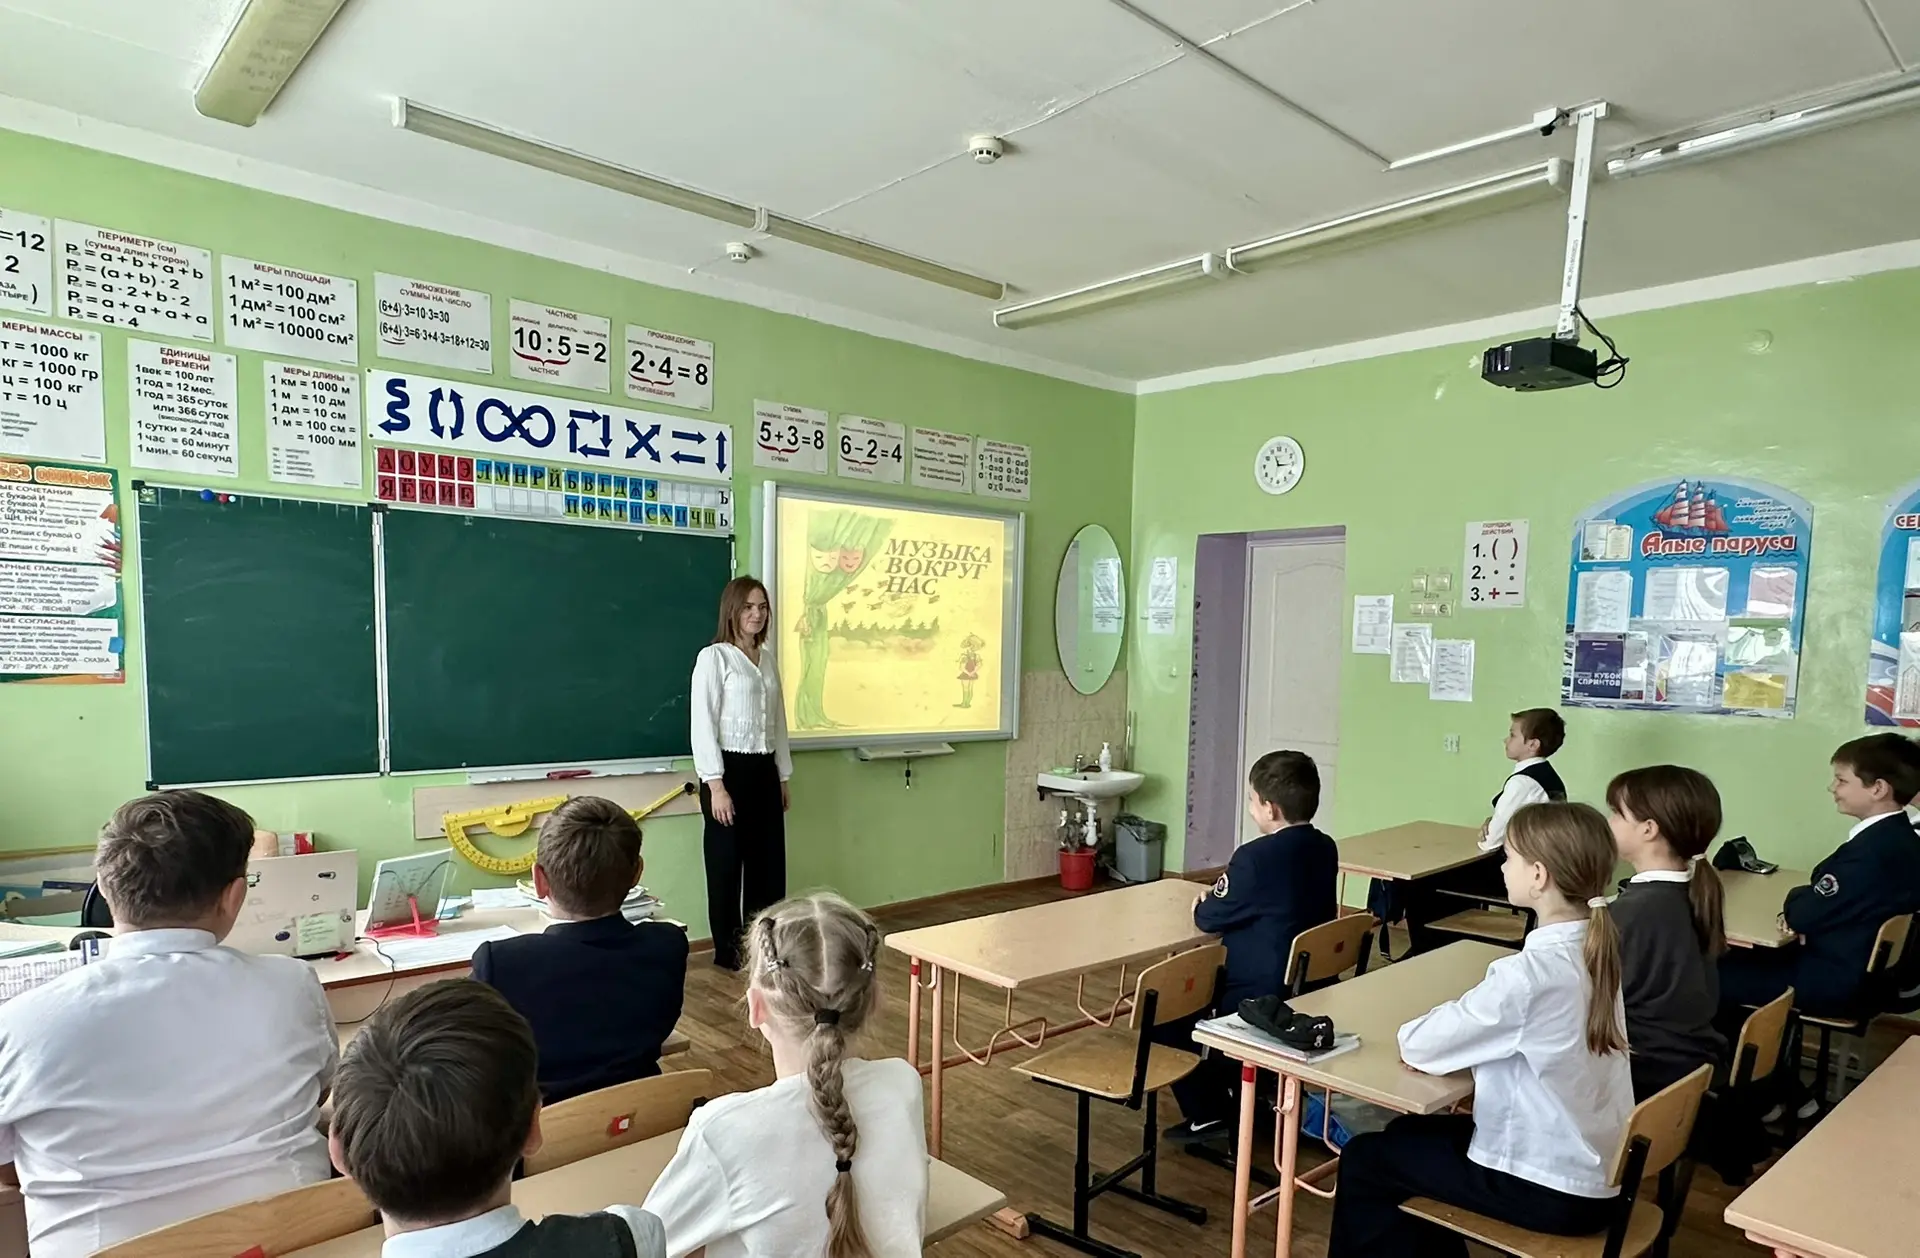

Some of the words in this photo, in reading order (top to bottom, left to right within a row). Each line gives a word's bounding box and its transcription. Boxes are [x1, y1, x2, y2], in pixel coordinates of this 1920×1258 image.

[97, 231, 155, 249] ПЕРИМЕТР
[158, 243, 176, 254] (см)
[85, 239, 121, 252] (сумма
[124, 248, 148, 258] длин
[151, 254, 189, 267] сторон)
[5, 256, 19, 273] 2
[254, 264, 282, 274] МЕРЫ
[284, 270, 332, 284] ПЛОЩАДИ
[229, 275, 235, 287] 1
[277, 284, 304, 299] 100
[410, 282, 461, 298] УМНОЖЕНИЕ
[400, 289, 430, 300] СУММЫ
[445, 298, 471, 308] ЧИСЛО
[230, 294, 236, 306] 1
[288, 305, 315, 320] 100
[546, 309, 577, 320] ЧАСТНОЕ
[2, 322, 37, 333] МЕРЫ
[40, 327, 82, 340] МАССЫ
[230, 314, 236, 326] 1
[278, 322, 324, 340] 10000
[646, 330, 697, 347] ПРОИЗВЕДЕНИЕ
[31, 343, 68, 358] 1000
[74, 352, 89, 361] кг
[160, 348, 210, 363] ЕДИНИЦЫ
[2, 358, 18, 367] кг
[40, 361, 76, 376] 1000
[82, 370, 98, 381] гр
[162, 357, 210, 371] ВРЕМЕНИ
[528, 366, 559, 376] ЧАСТНОЕ
[176, 371, 194, 380] 100
[284, 367, 310, 376] МЕРЫ
[312, 371, 344, 381] ДЛИНЫ
[3, 376, 13, 386] ц
[35, 378, 62, 390] 100
[68, 384, 82, 393] кг
[144, 380, 163, 388] год
[177, 383, 188, 391] 12
[191, 386, 214, 395] мес.
[271, 375, 275, 384] 1
[312, 381, 338, 392] 1000
[3, 392, 12, 400] т
[33, 394, 51, 406] 10
[57, 400, 67, 410] ц
[144, 392, 163, 400] год
[177, 394, 196, 404] 365
[198, 399, 227, 408] суток
[271, 389, 276, 397] 1
[313, 394, 325, 404] 10
[178, 406, 197, 416] 366
[199, 411, 229, 420] суток
[272, 403, 276, 411] 1
[282, 406, 299, 414] дм
[314, 408, 327, 417] 10
[145, 423, 176, 432] сутки
[190, 427, 202, 435] 24
[204, 431, 229, 439] часа
[272, 416, 277, 425] 1
[307, 420, 326, 430] 100
[182, 438, 194, 446] 60
[196, 442, 229, 451] минут
[308, 434, 334, 445] 1000
[182, 449, 194, 458] 60
[196, 453, 232, 463] секунд
[36, 467, 111, 488] ОШИБОК
[381, 454, 392, 469] А
[401, 453, 414, 472] О
[420, 456, 433, 473] У
[440, 458, 454, 474] Ы
[460, 461, 470, 477] Э
[477, 464, 490, 479] Л
[495, 465, 510, 482] М
[514, 467, 526, 484] Н
[532, 468, 544, 486] Р
[550, 469, 560, 487] Й
[568, 473, 577, 489] Б
[584, 475, 593, 492] В
[600, 477, 609, 493] Г
[615, 478, 626, 498] Д
[647, 482, 655, 498] З
[719, 490, 728, 504] Ъ
[16, 486, 72, 495] СОЧЕТАНИЯ
[381, 477, 393, 496] Я
[567, 498, 578, 514] П
[582, 498, 594, 515] Ф
[600, 500, 610, 516] К
[616, 502, 626, 518] Т
[646, 506, 657, 522] С
[661, 506, 672, 523] Х
[690, 509, 700, 524] Ч
[720, 513, 728, 527] Ь
[1895, 514, 1920, 528] СЕ
[884, 538, 992, 563] МУЗЫКА
[1473, 544, 1486, 557] 1.
[1642, 531, 1705, 556] Алые
[1712, 535, 1795, 555] паруса
[884, 557, 988, 579] ВОКРУГ
[1472, 566, 1485, 579] 2.
[885, 575, 938, 595] НАС
[1471, 587, 1484, 601] 3.
